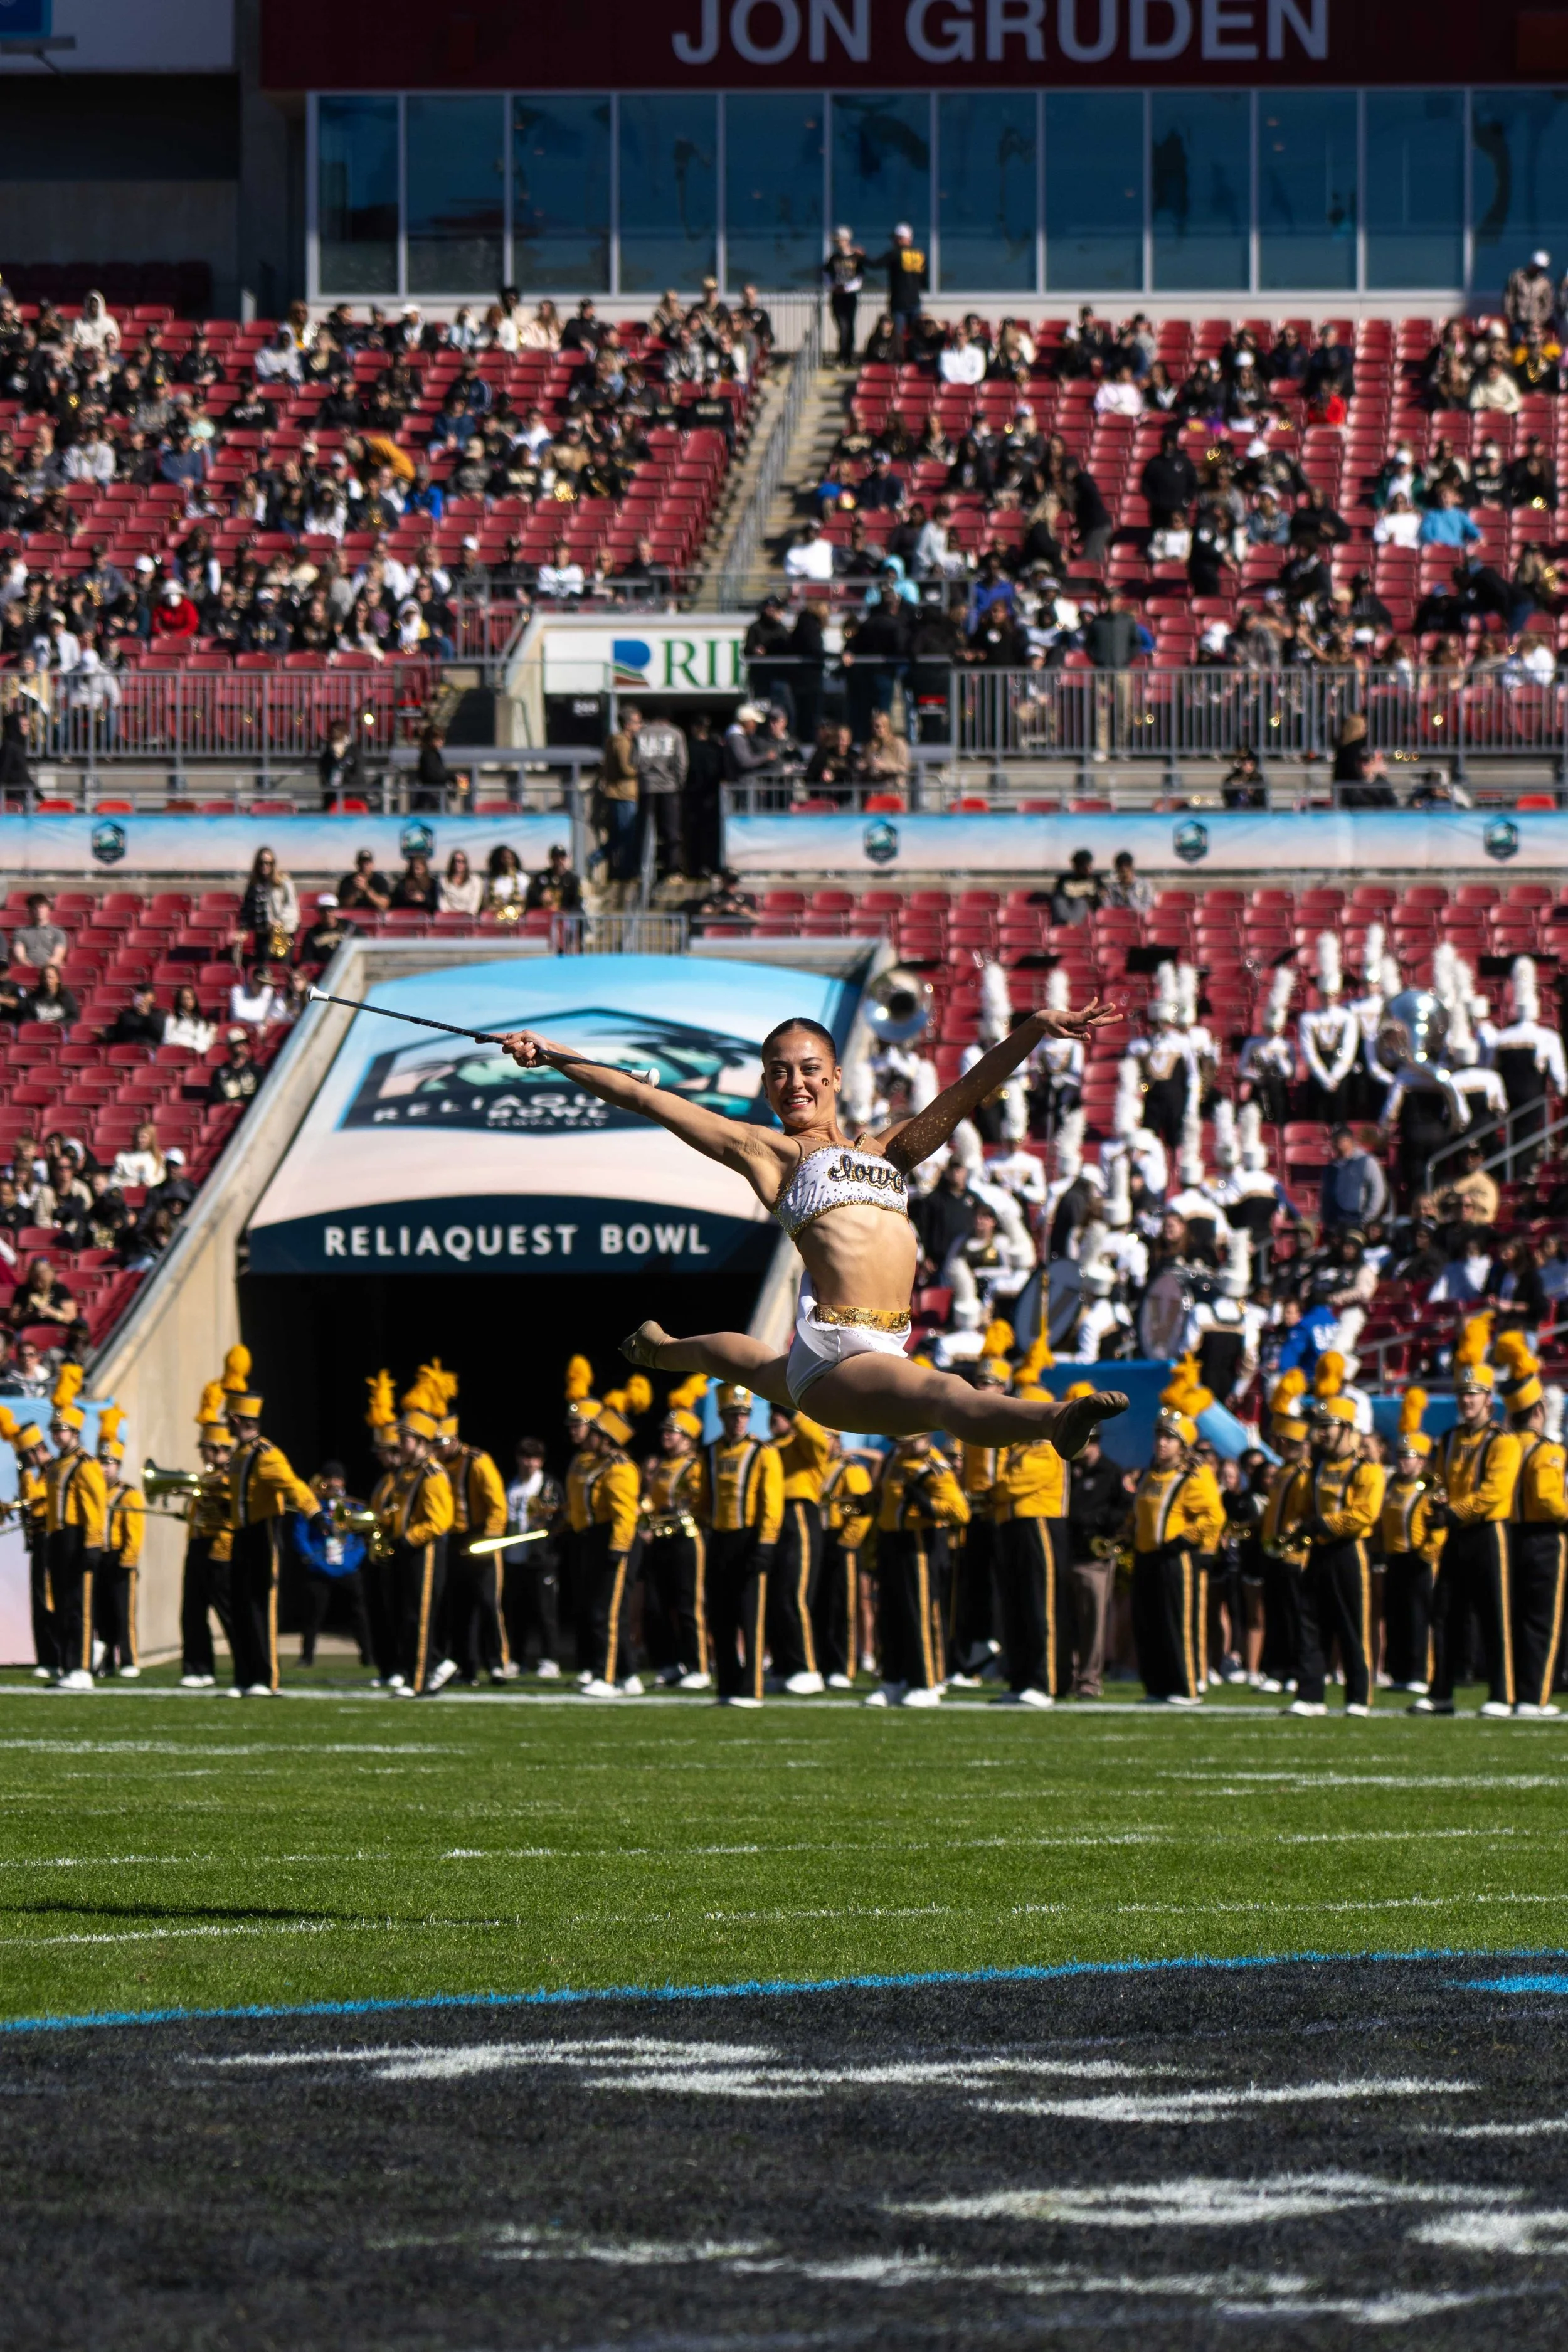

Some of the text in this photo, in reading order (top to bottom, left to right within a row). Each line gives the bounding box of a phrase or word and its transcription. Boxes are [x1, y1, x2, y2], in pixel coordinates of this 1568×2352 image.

[672, 0, 1328, 64] JON GRUDEN
[373, 1093, 607, 1123] RELIAQU
[828, 1153, 905, 1195] Iowa
[324, 1224, 709, 1261] RELIAQUEST BOWL
